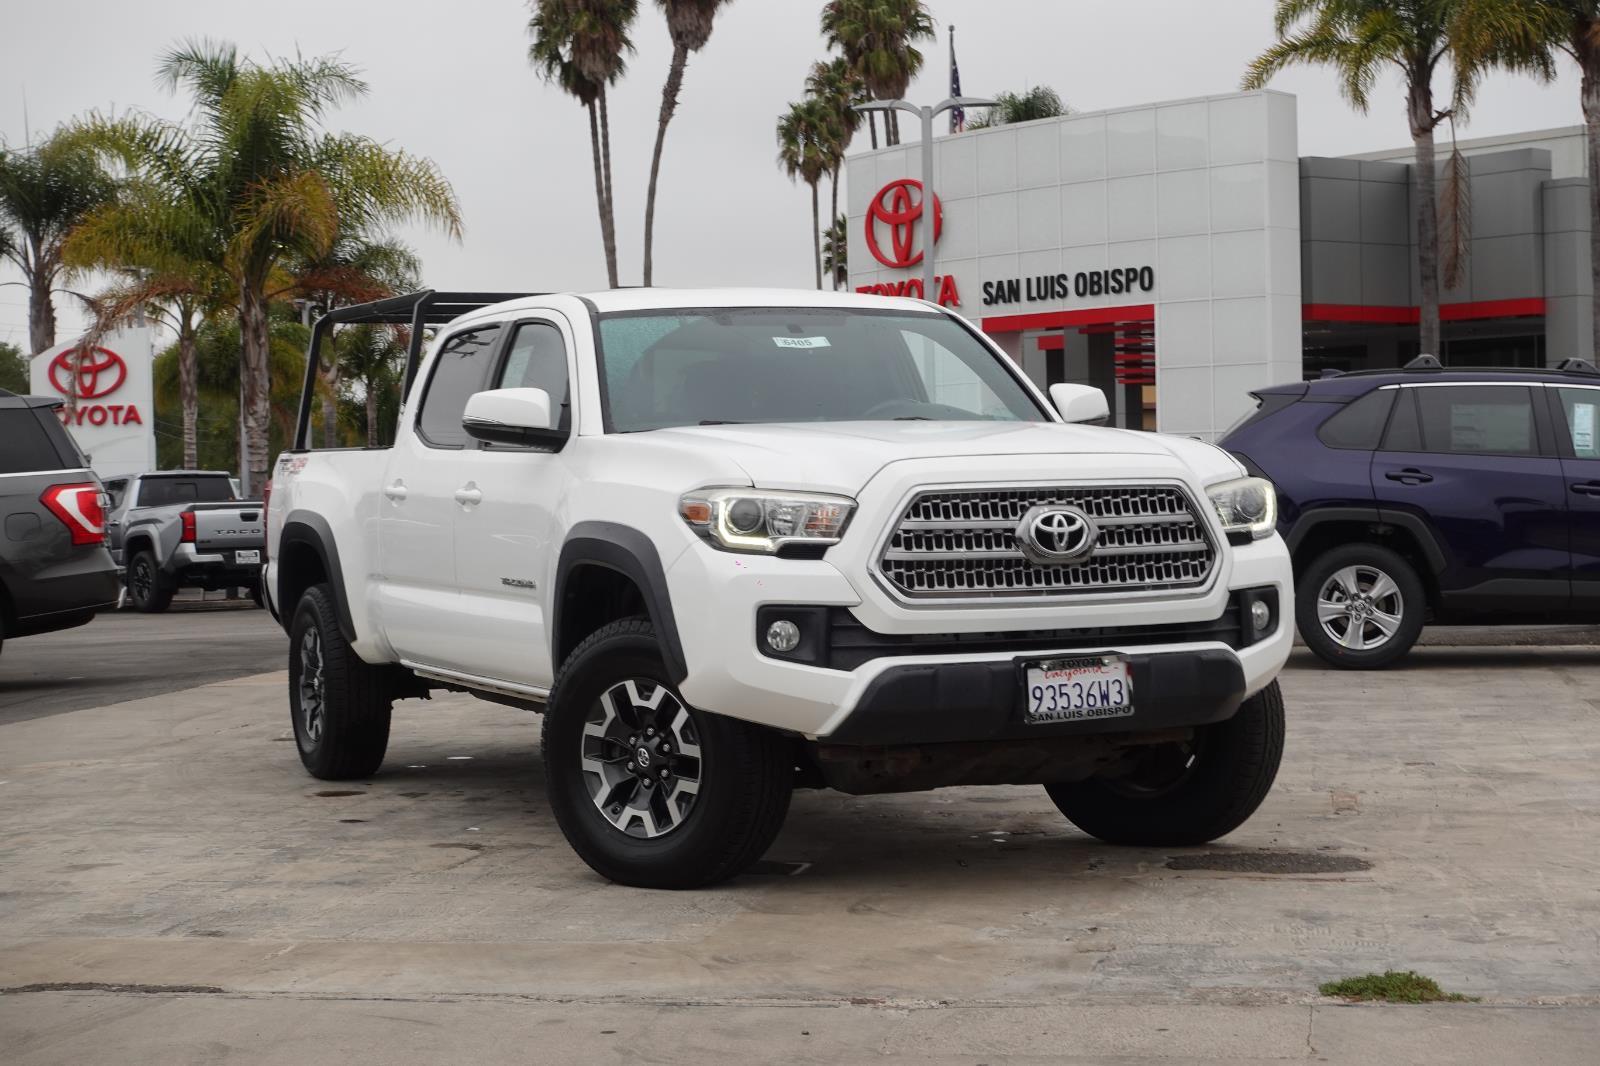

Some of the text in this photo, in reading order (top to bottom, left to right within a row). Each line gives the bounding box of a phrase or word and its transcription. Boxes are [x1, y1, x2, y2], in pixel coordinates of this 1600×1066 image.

[855, 275, 961, 307] YOA
[982, 265, 1154, 306] SAN LUIS OBISPO
[782, 338, 813, 347] 6405
[52, 404, 143, 426] OYOTA
[1032, 679, 1124, 712] 93536W3
[1030, 706, 1130, 723] SAN LUIS OBISPO
